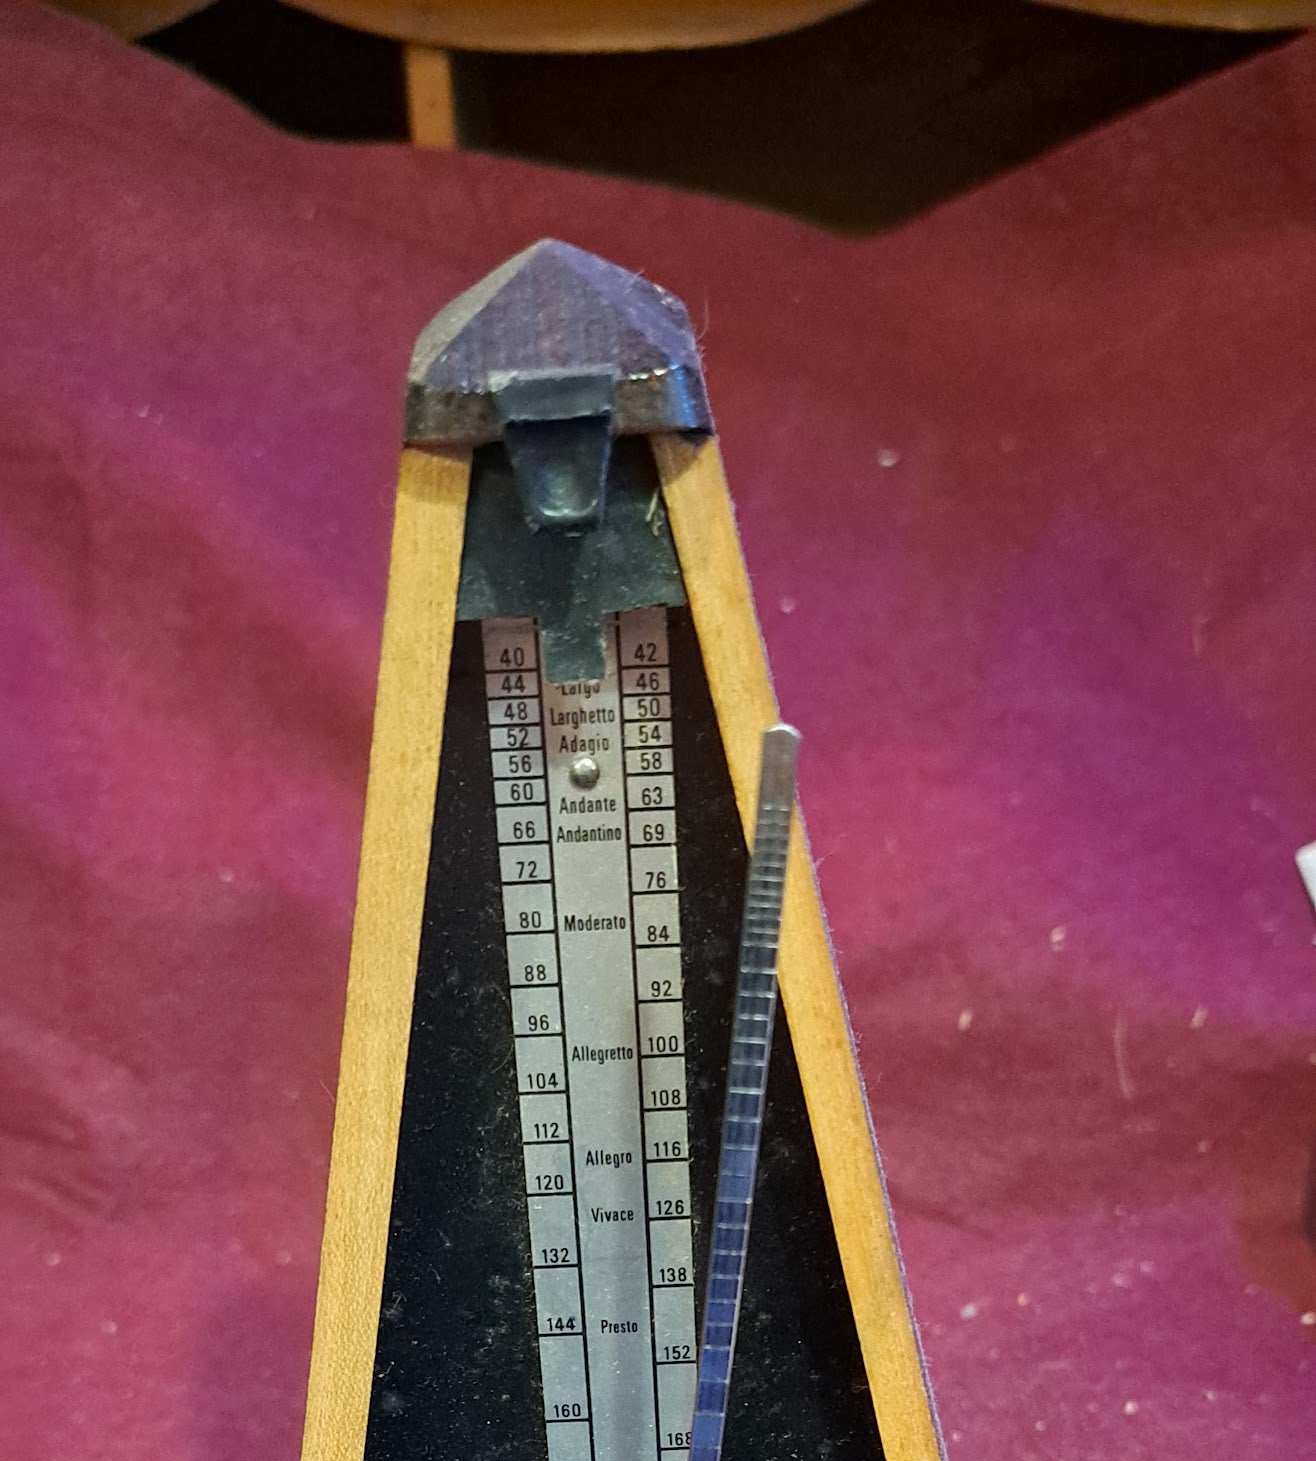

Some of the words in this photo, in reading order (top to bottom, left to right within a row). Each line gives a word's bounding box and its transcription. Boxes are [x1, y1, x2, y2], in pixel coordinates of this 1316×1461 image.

[500, 647, 525, 666] 40
[634, 643, 657, 662] 42
[502, 675, 526, 693] 44
[636, 672, 660, 691] 46
[504, 702, 528, 721] 48
[638, 698, 660, 717] 50
[551, 707, 615, 729] Larghetto
[507, 729, 529, 748] 52
[639, 725, 661, 743] 54
[559, 733, 610, 755] Adagio
[509, 755, 532, 773] 56
[641, 752, 662, 770] 58
[511, 783, 534, 801] 60
[642, 787, 663, 805] 63
[559, 797, 617, 815] Andante
[513, 821, 536, 839] 66
[556, 825, 622, 843] Andantino
[643, 823, 664, 842] 69
[516, 861, 538, 879] 72
[645, 871, 666, 889] 76
[519, 911, 541, 929] 80
[564, 914, 626, 932] Moderato
[647, 925, 670, 942] 84
[524, 964, 547, 982] 88
[651, 980, 672, 997] 92
[528, 1015, 549, 1031] 96
[648, 1035, 679, 1053] 100
[572, 1046, 633, 1065] Allegretto
[527, 1072, 559, 1089] 104
[651, 1089, 681, 1107] 108
[534, 1123, 560, 1139] 112
[653, 1141, 681, 1157] 116
[586, 1150, 632, 1168] Allegro
[535, 1174, 564, 1190] 120
[591, 1207, 634, 1223] Vivace
[656, 1200, 684, 1216] 126
[542, 1248, 569, 1264] 132
[659, 1267, 687, 1283] 138
[547, 1317, 576, 1331] 144
[601, 1319, 639, 1334] Presto
[663, 1345, 691, 1360] 152
[553, 1403, 581, 1418] 160
[667, 1431, 692, 1446] 168
